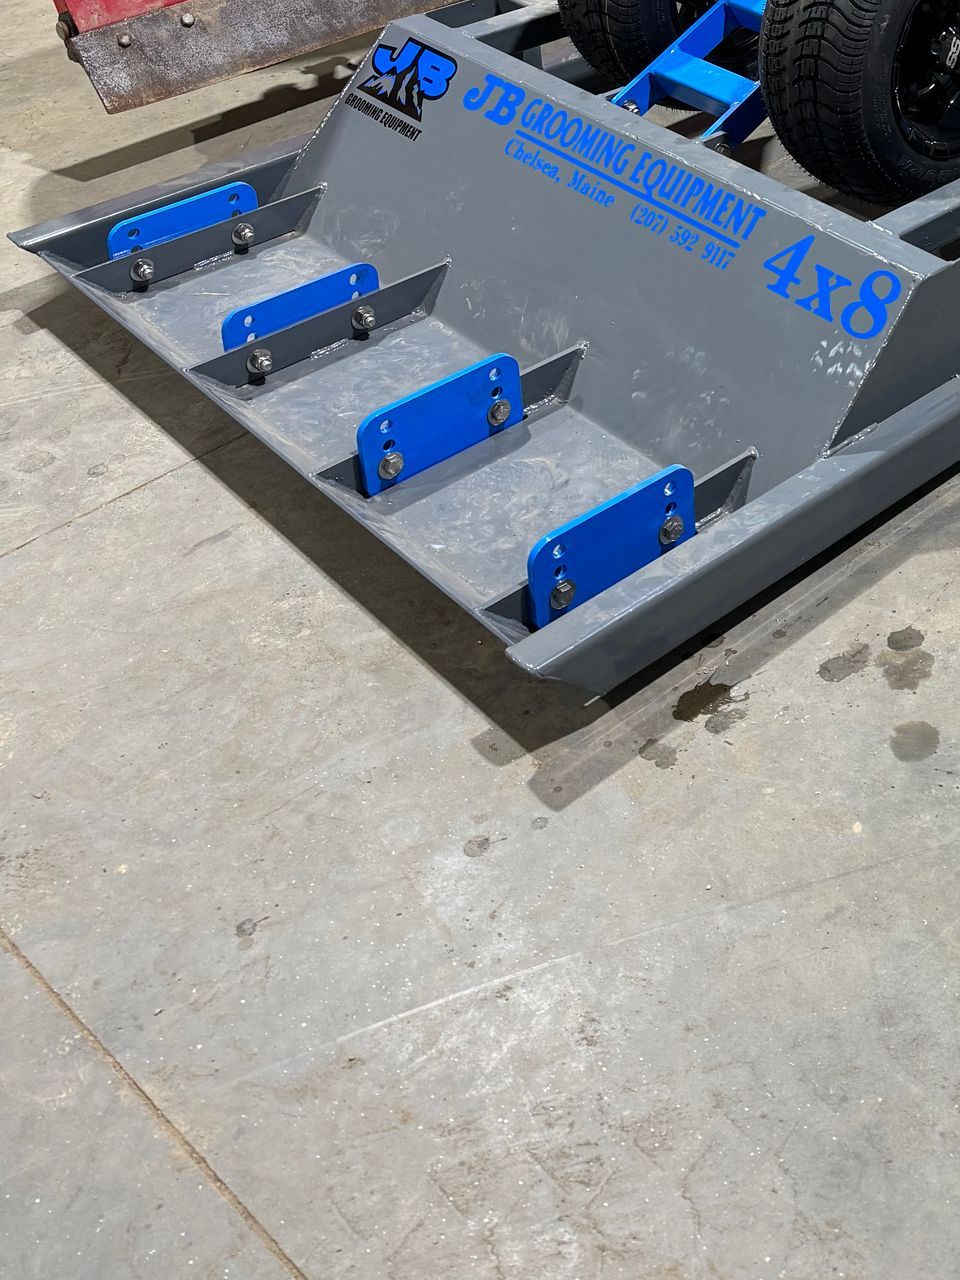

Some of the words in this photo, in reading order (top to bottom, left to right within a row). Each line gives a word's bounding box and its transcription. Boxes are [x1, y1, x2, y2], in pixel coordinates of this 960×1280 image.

[344, 92, 384, 124] GROOMING
[379, 111, 423, 142] EQUIPMENT
[372, 36, 458, 101] JB
[462, 73, 526, 126] JB
[520, 98, 636, 175] GROOMING
[628, 151, 768, 241] EQUIPMENT
[504, 138, 561, 184] Chelsea,
[567, 170, 615, 208] Maine
[630, 203, 669, 236] (207)
[668, 225, 700, 252] 592
[701, 241, 736, 270] 9117
[763, 234, 902, 340] 4x8
